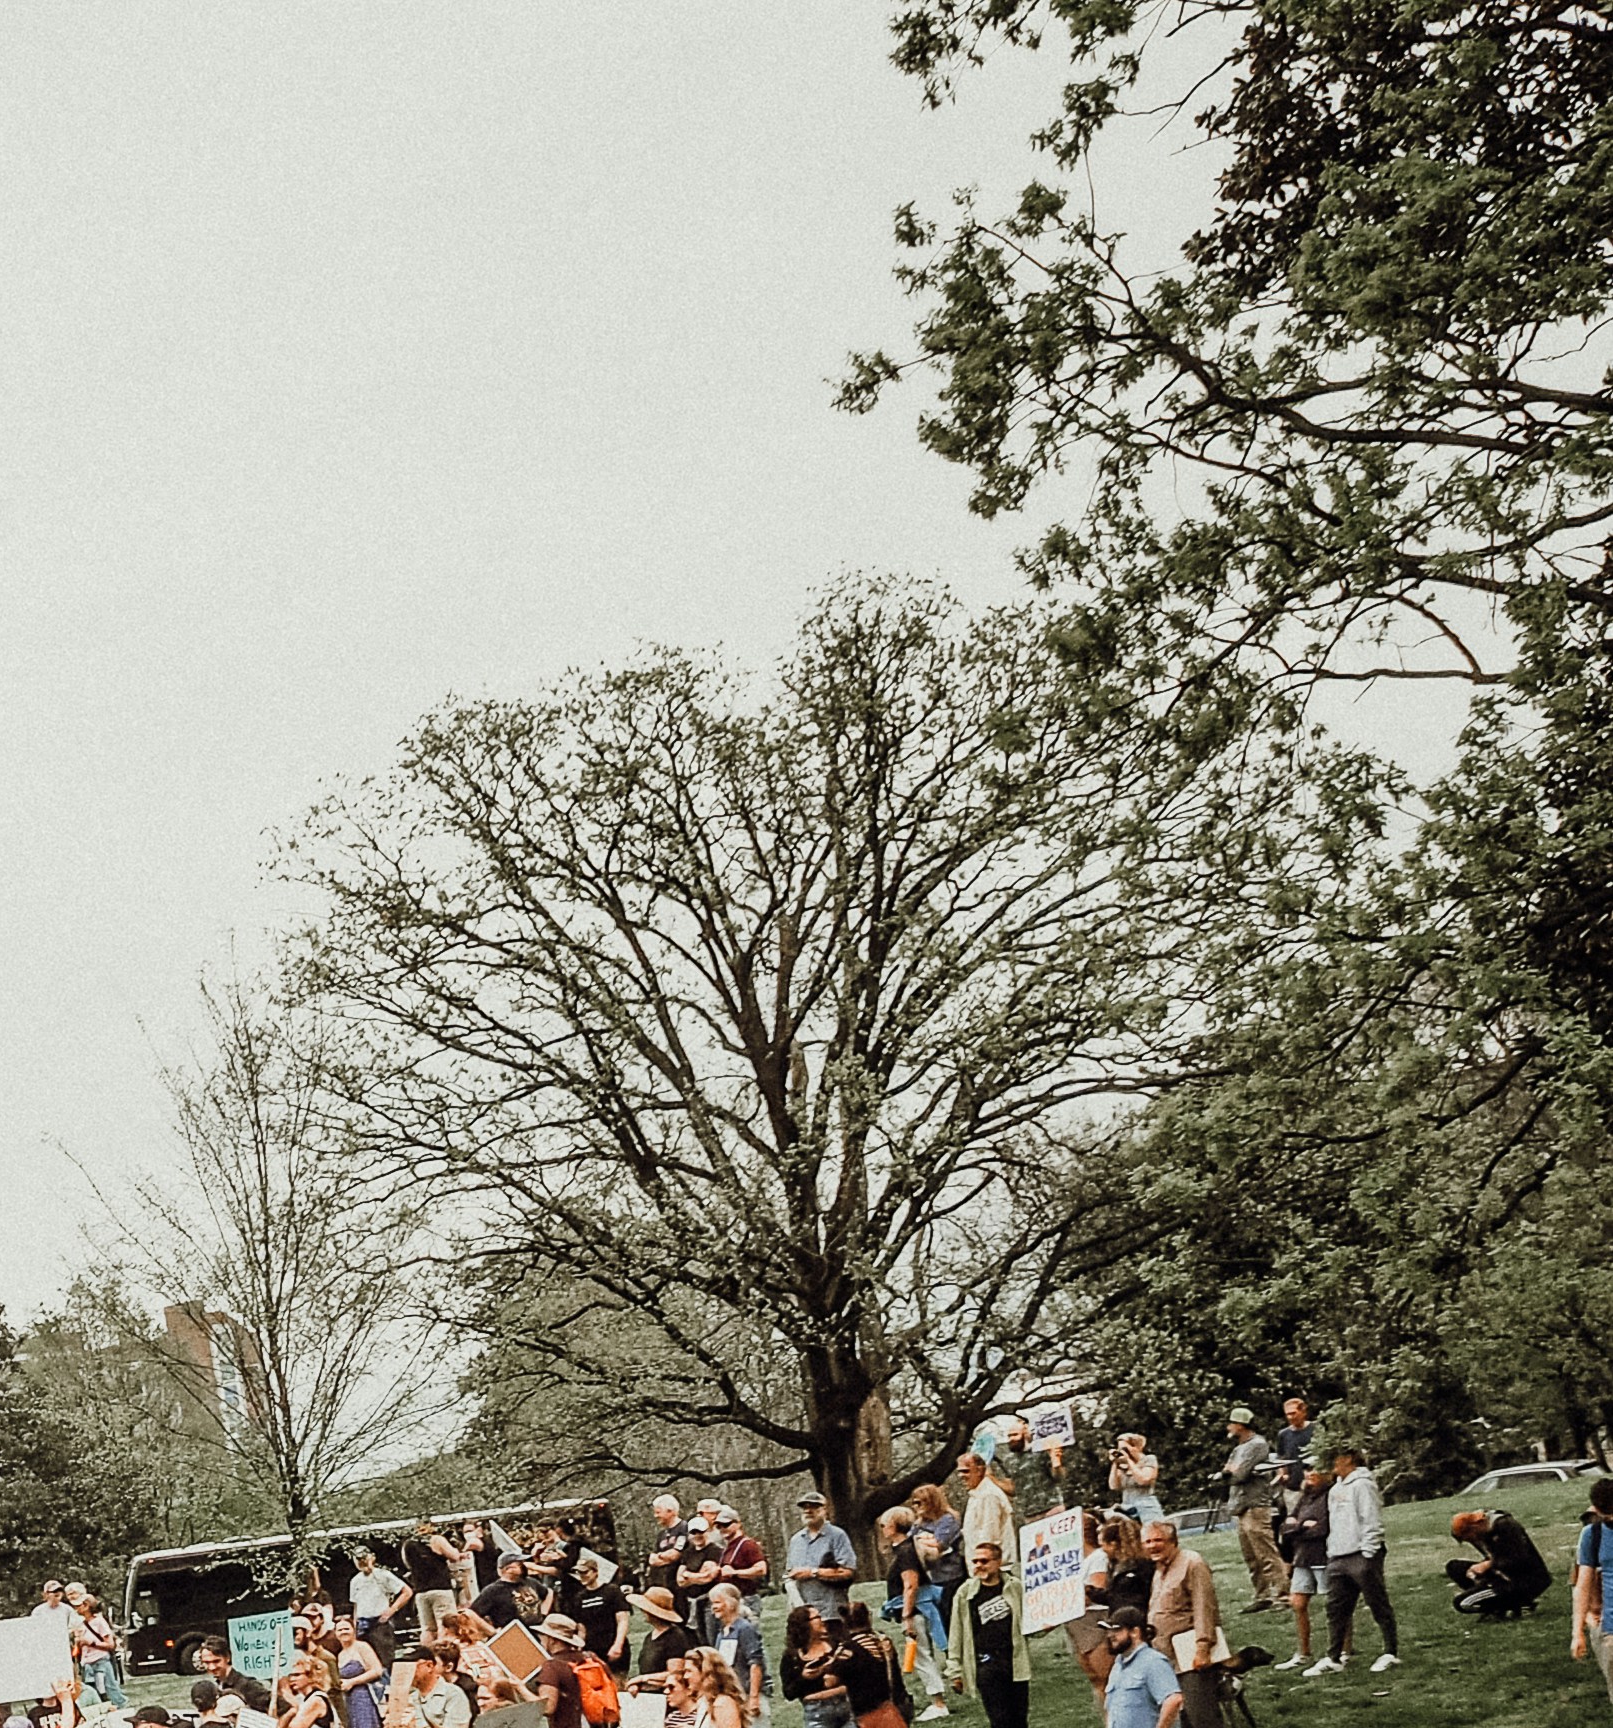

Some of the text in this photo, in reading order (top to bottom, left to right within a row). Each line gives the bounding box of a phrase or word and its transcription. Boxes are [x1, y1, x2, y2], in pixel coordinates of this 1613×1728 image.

[1050, 1516, 1076, 1535] KEEP
[1025, 1549, 1080, 1578] MAN BABY
[1025, 1569, 1062, 1592] HANDS
[1027, 1591, 1044, 1607] GO
[238, 1615, 289, 1632] HANDS OFF
